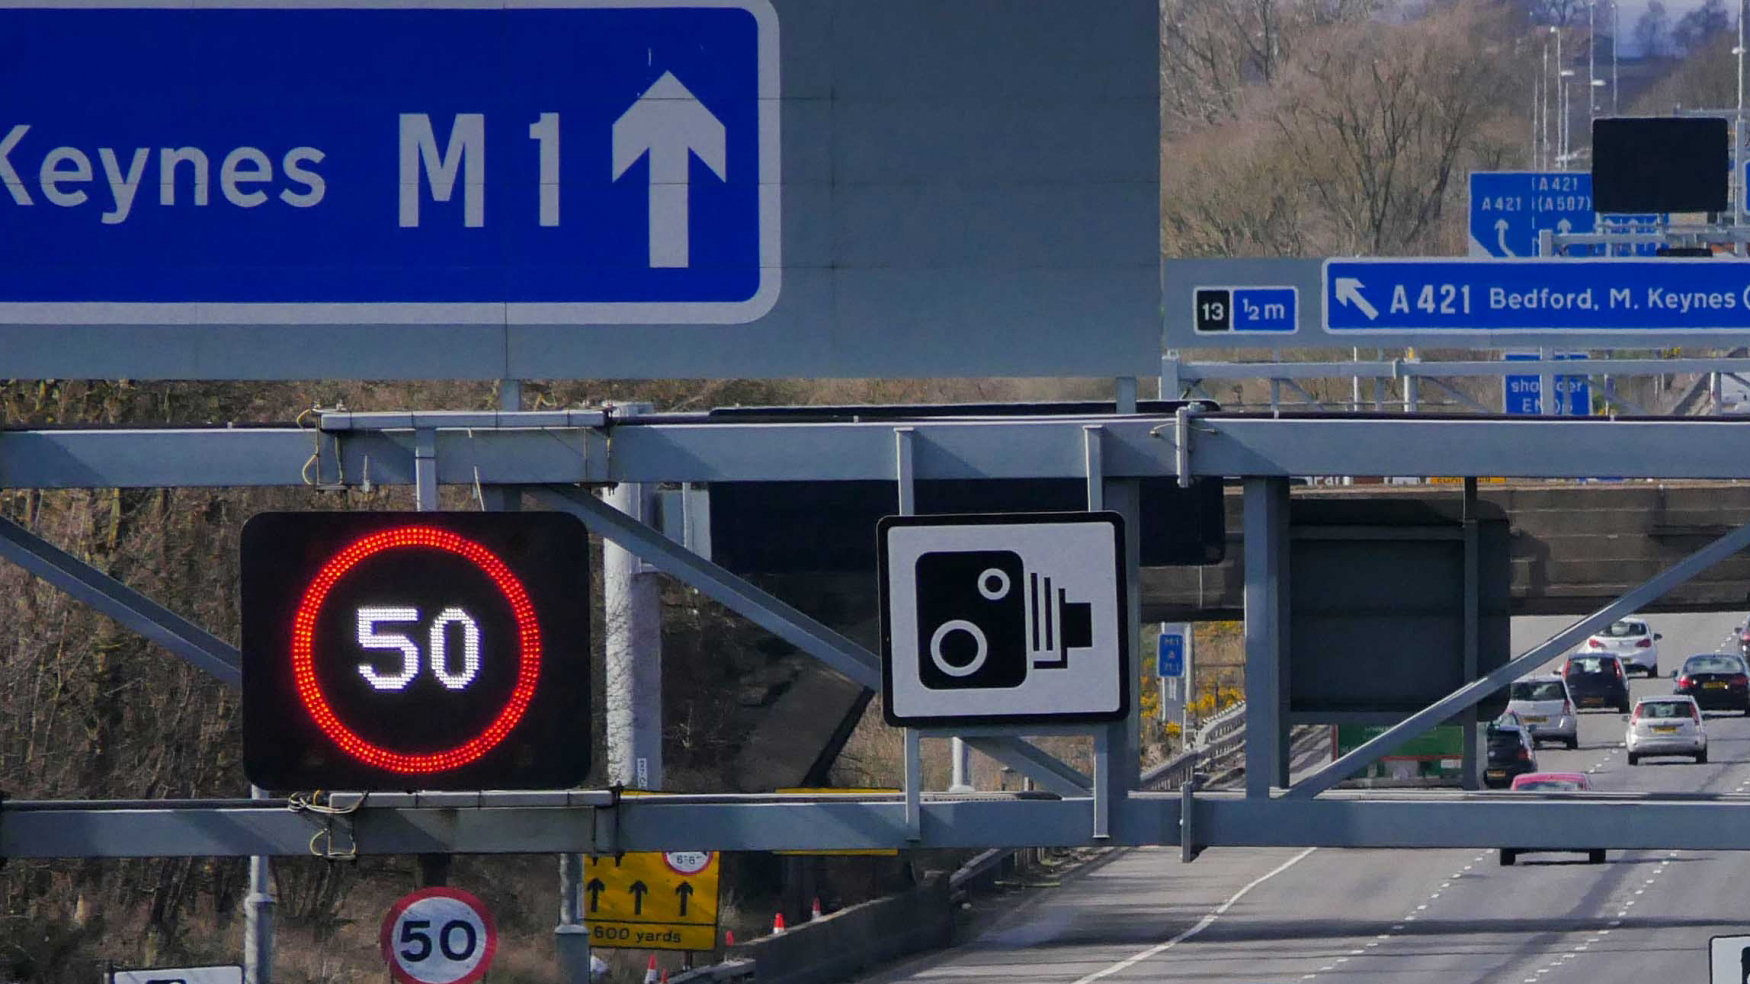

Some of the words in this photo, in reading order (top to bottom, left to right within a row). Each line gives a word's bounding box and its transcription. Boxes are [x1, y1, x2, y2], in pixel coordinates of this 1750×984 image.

[1539, 177, 1577, 191] A421
[1482, 197, 1521, 211] A421
[1648, 288, 1736, 313] Keynes
[1203, 303, 1223, 320] 13
[358, 607, 479, 689] 50
[400, 919, 477, 962] 50
[594, 926, 629, 940] 600
[636, 930, 682, 943] yards
